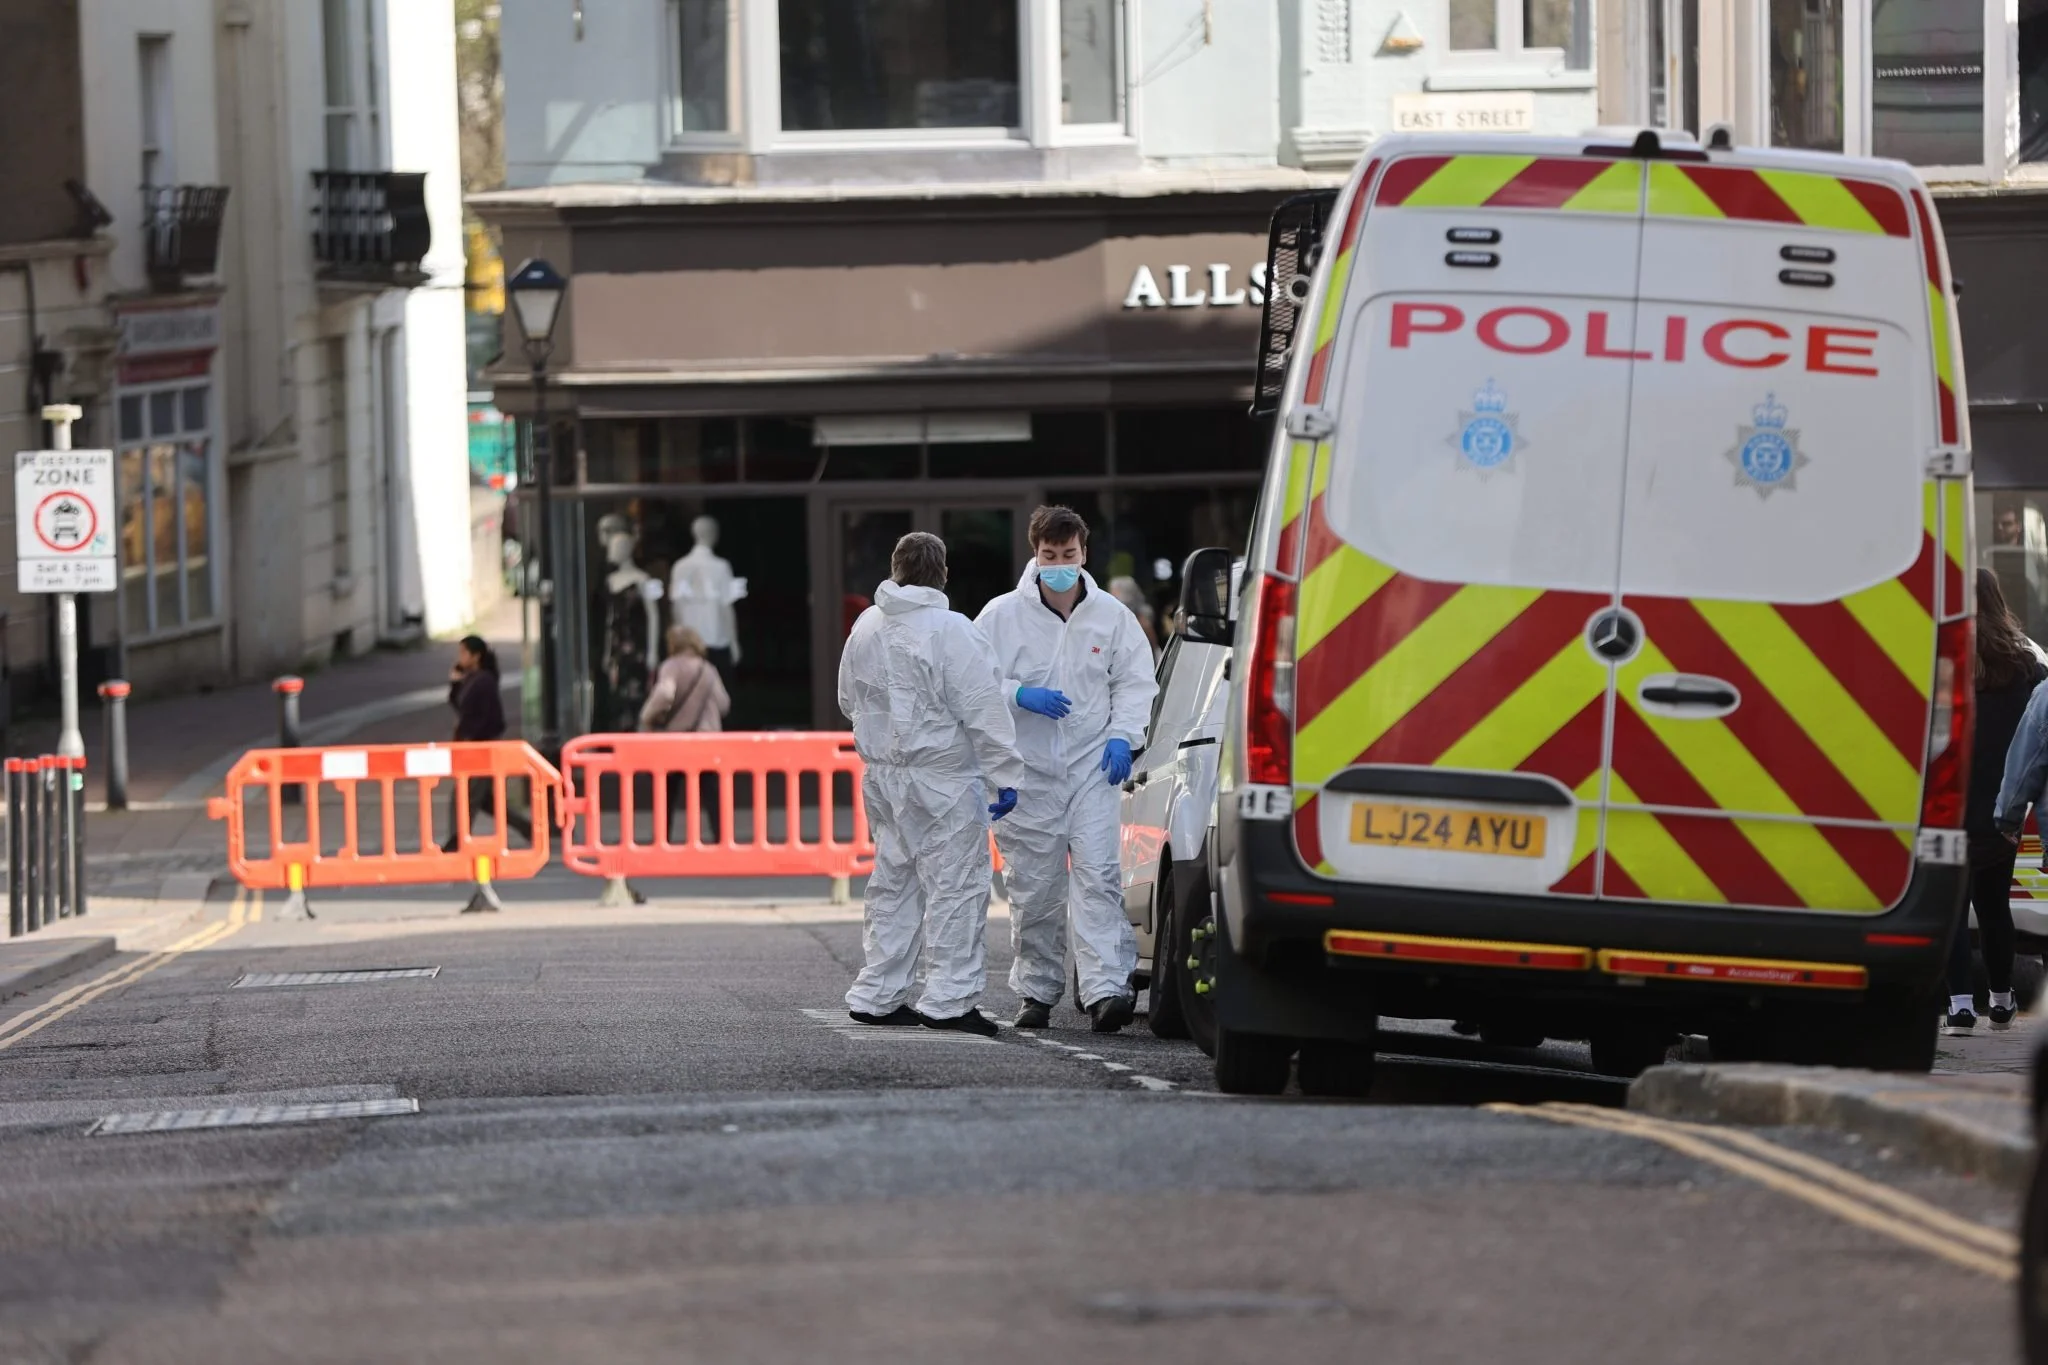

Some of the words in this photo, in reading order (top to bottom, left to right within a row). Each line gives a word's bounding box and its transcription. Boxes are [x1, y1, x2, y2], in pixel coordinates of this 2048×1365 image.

[1877, 65, 1981, 79] jonesbootmaker.com
[1400, 110, 1444, 128] EAST
[1456, 109, 1526, 128] STREET
[1389, 302, 1880, 378] POLICE
[34, 469, 94, 485] ZONE
[1091, 646, 1101, 654] 3M
[1364, 809, 1452, 844] LJ24
[1464, 816, 1532, 850] AYU
